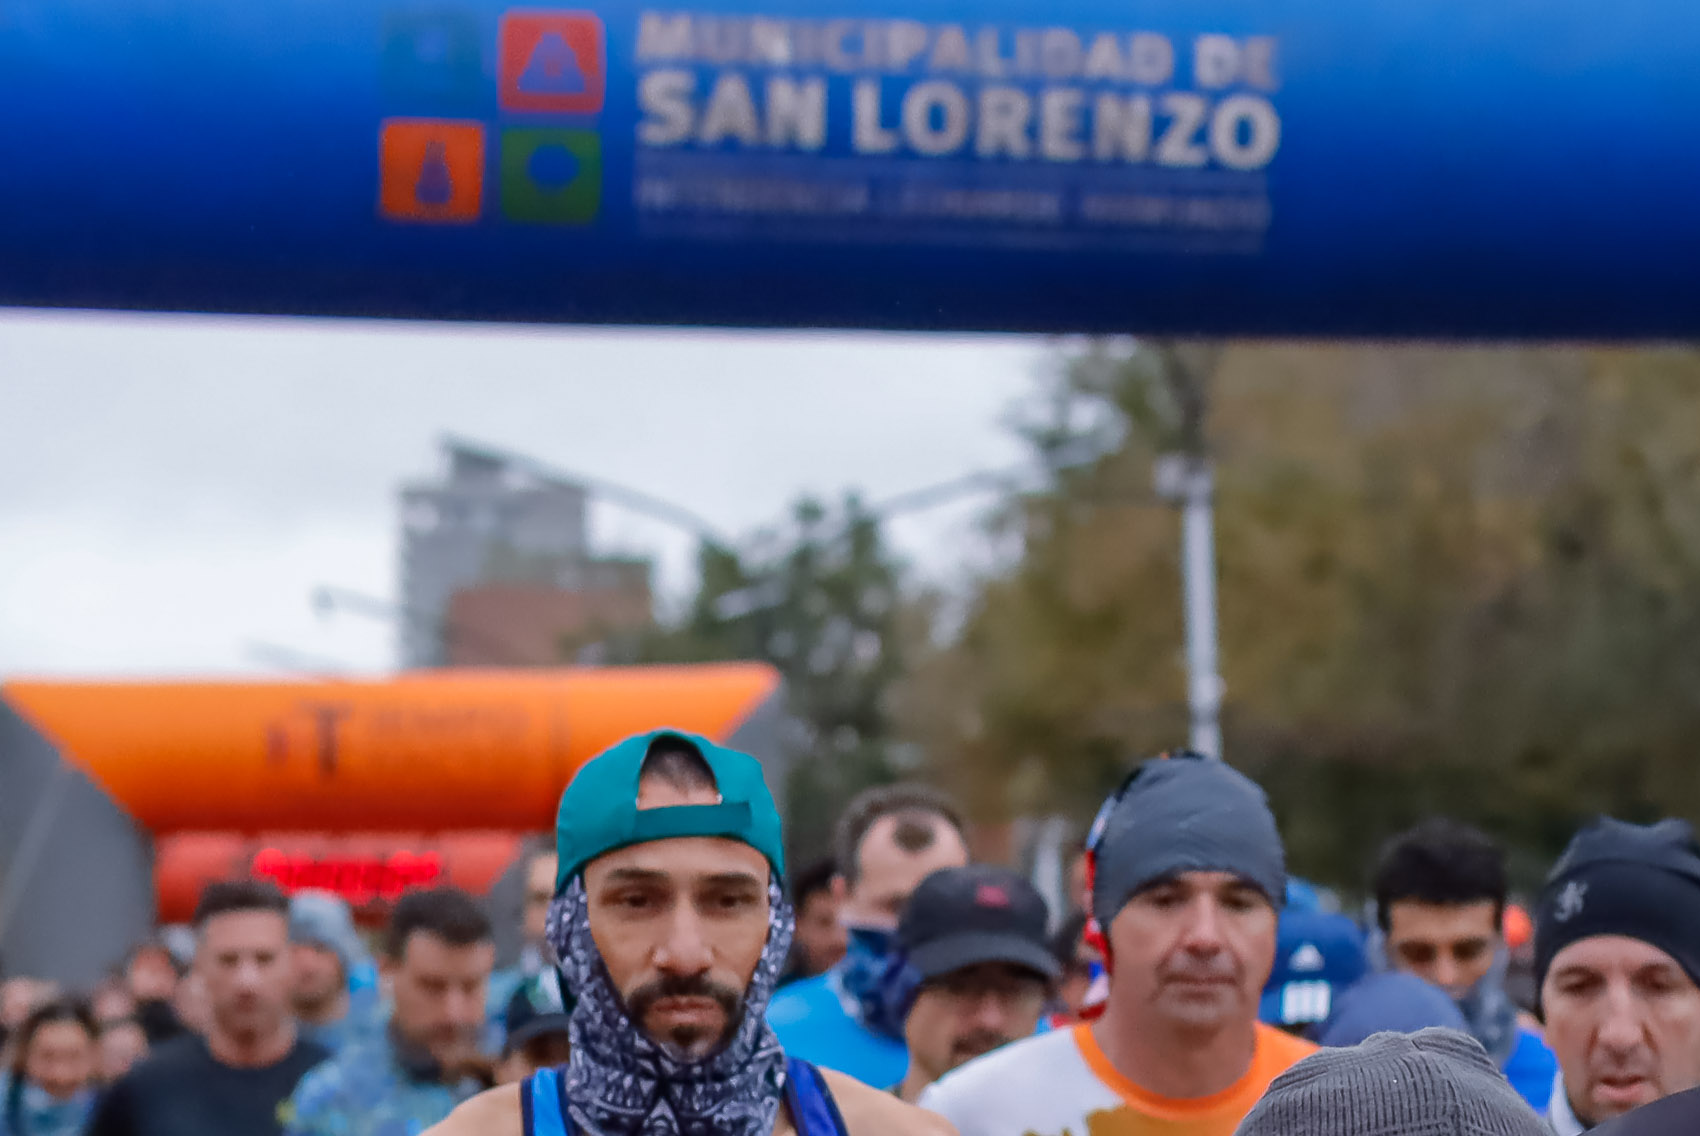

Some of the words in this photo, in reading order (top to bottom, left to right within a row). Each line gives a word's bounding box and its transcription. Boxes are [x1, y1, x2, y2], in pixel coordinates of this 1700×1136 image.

[635, 8, 1174, 88] MUNICIPALIDAD
[1194, 32, 1279, 91] DE
[637, 68, 826, 153] SAN
[853, 77, 1281, 171] LORENZO
